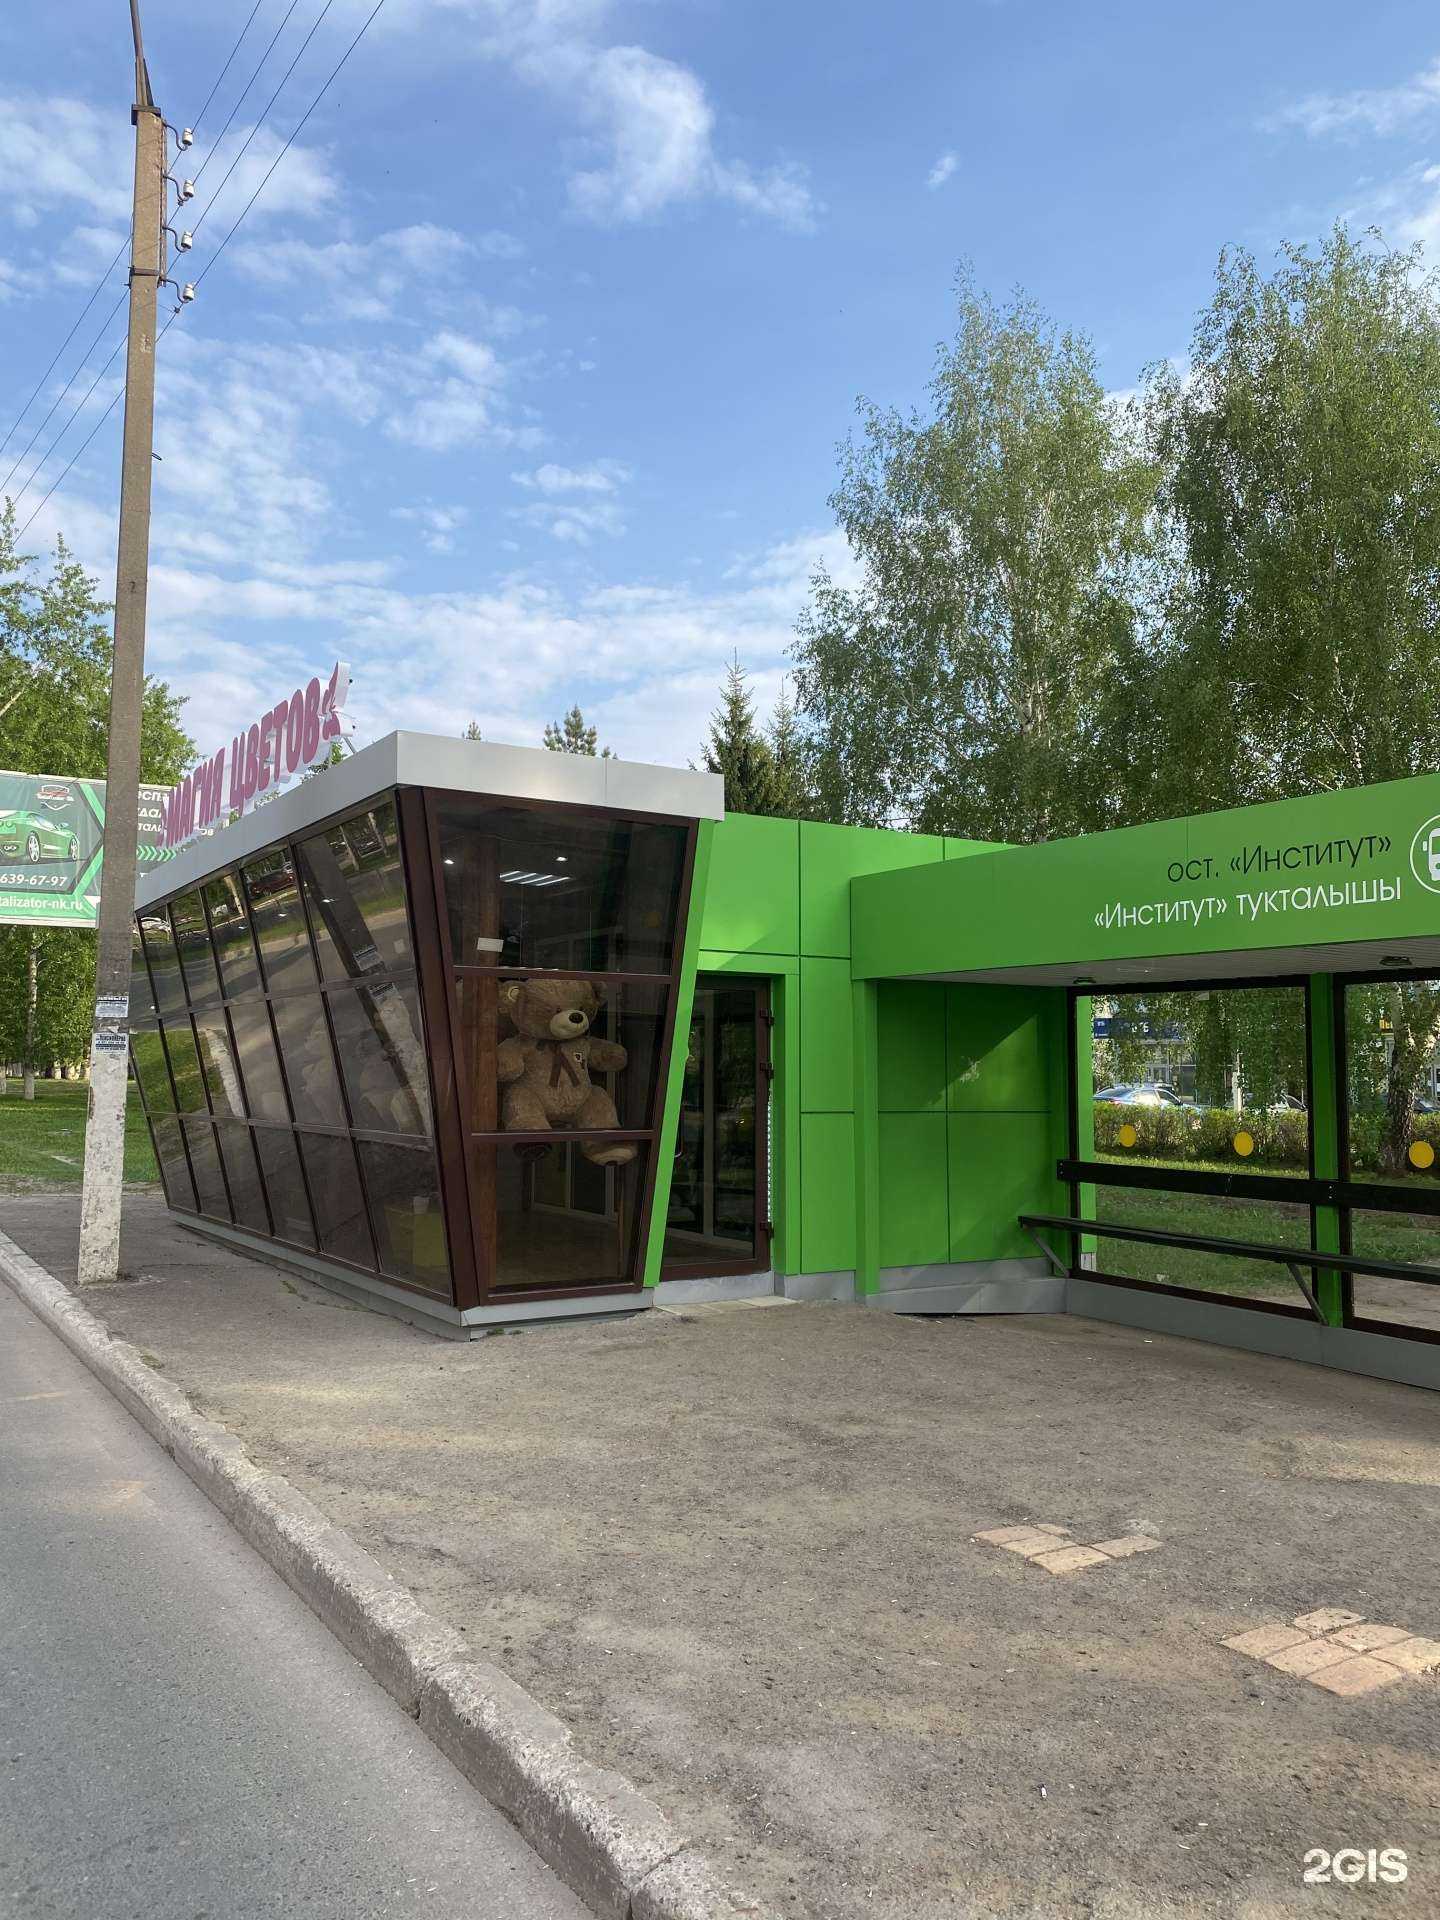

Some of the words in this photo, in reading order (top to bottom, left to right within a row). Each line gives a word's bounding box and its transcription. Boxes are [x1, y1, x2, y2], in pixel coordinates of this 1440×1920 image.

[167, 747, 226, 848] МАГИЯ
[229, 677, 321, 817] ЦВЕТОВ
[1167, 857, 1219, 883] ост.
[1229, 835, 1392, 876] «Институт»
[1094, 896, 1227, 928] «Институт»
[1237, 876, 1402, 921] тукталышы
